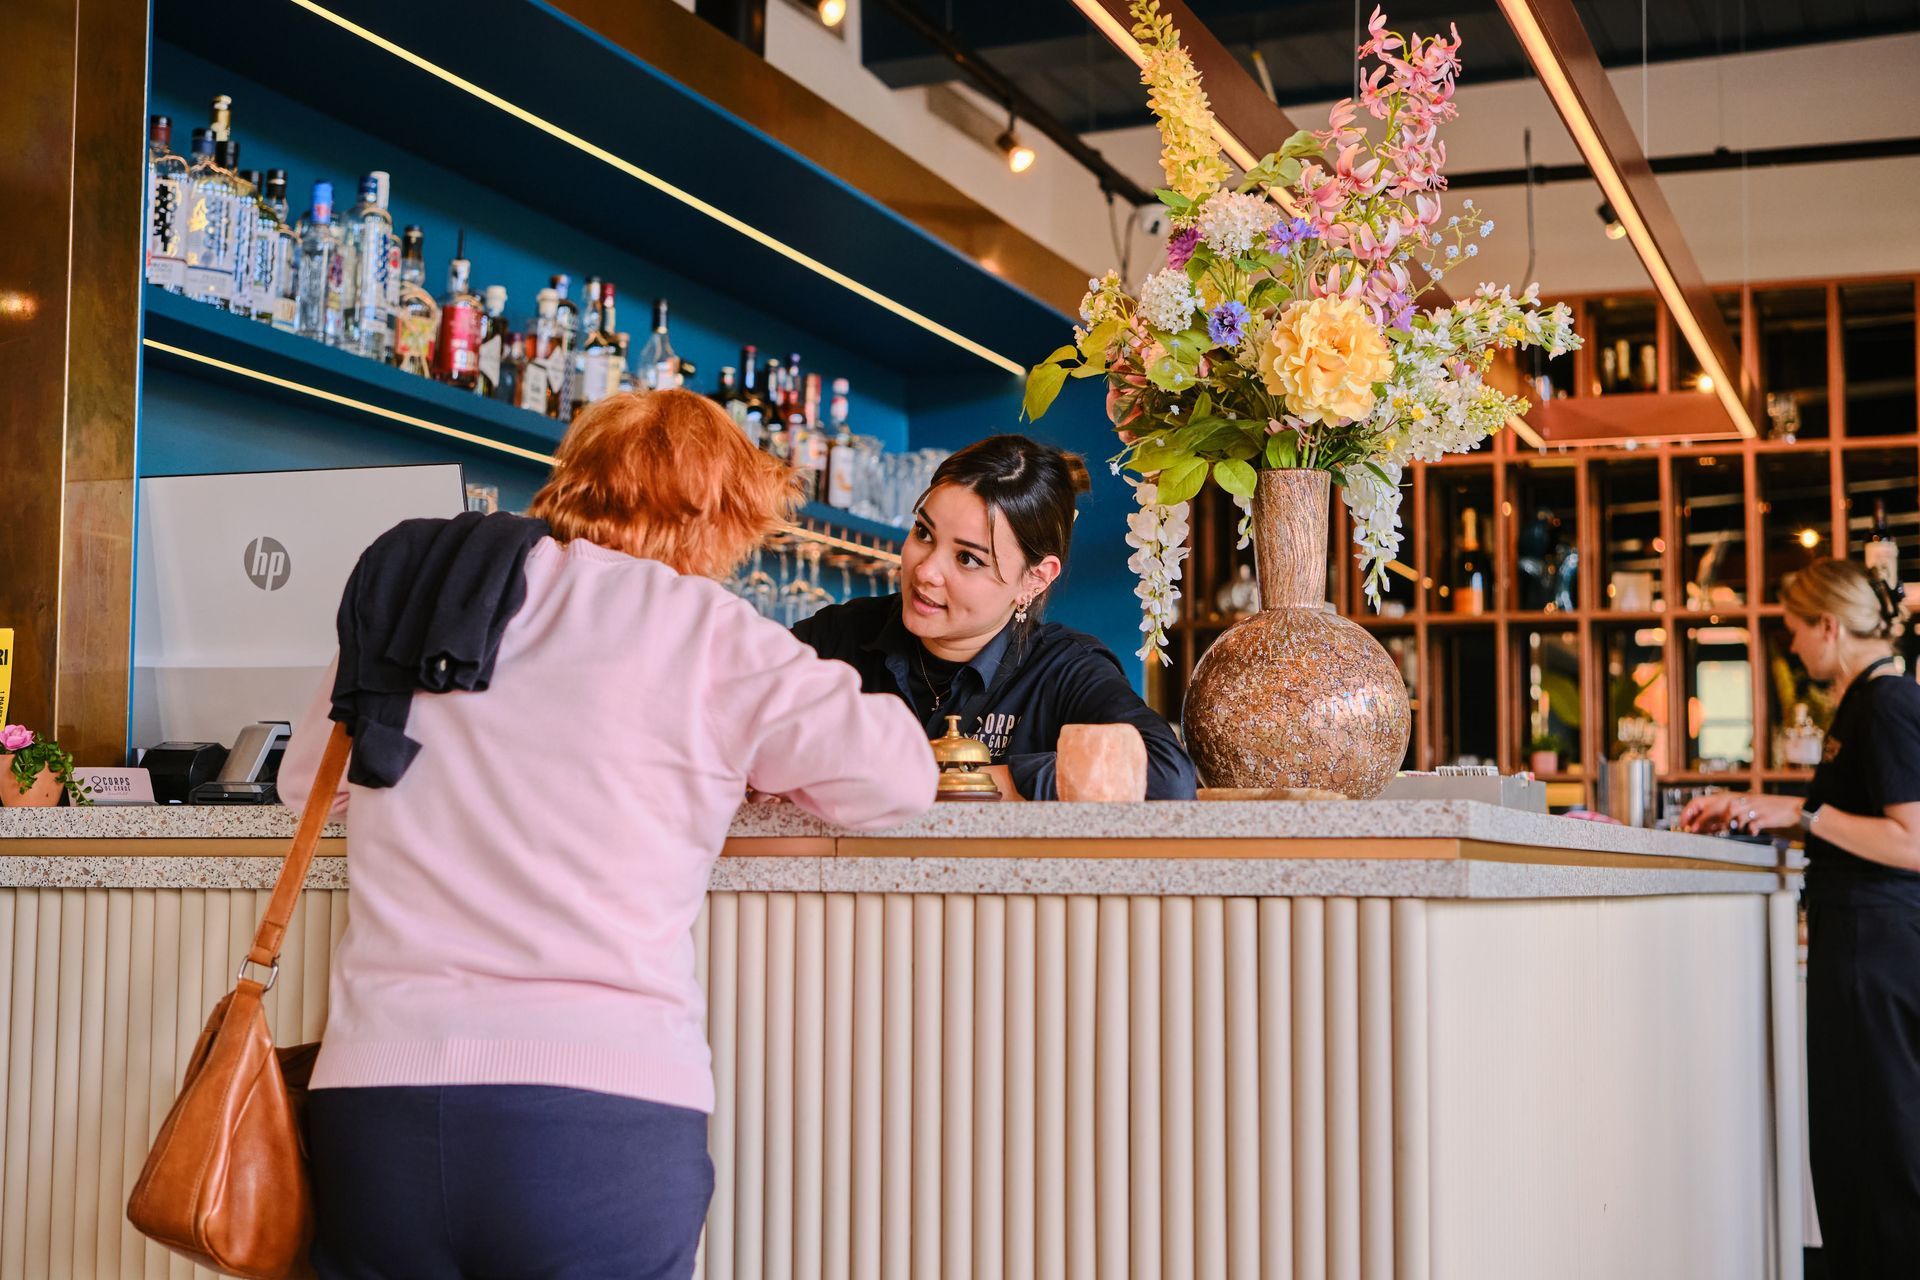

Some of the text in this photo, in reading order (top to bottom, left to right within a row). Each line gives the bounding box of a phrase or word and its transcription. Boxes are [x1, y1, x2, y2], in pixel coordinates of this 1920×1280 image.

[251, 536, 285, 591] hp
[976, 712, 1021, 735] ORP
[988, 734, 1012, 749] GAR
[102, 777, 131, 786] CORPS
